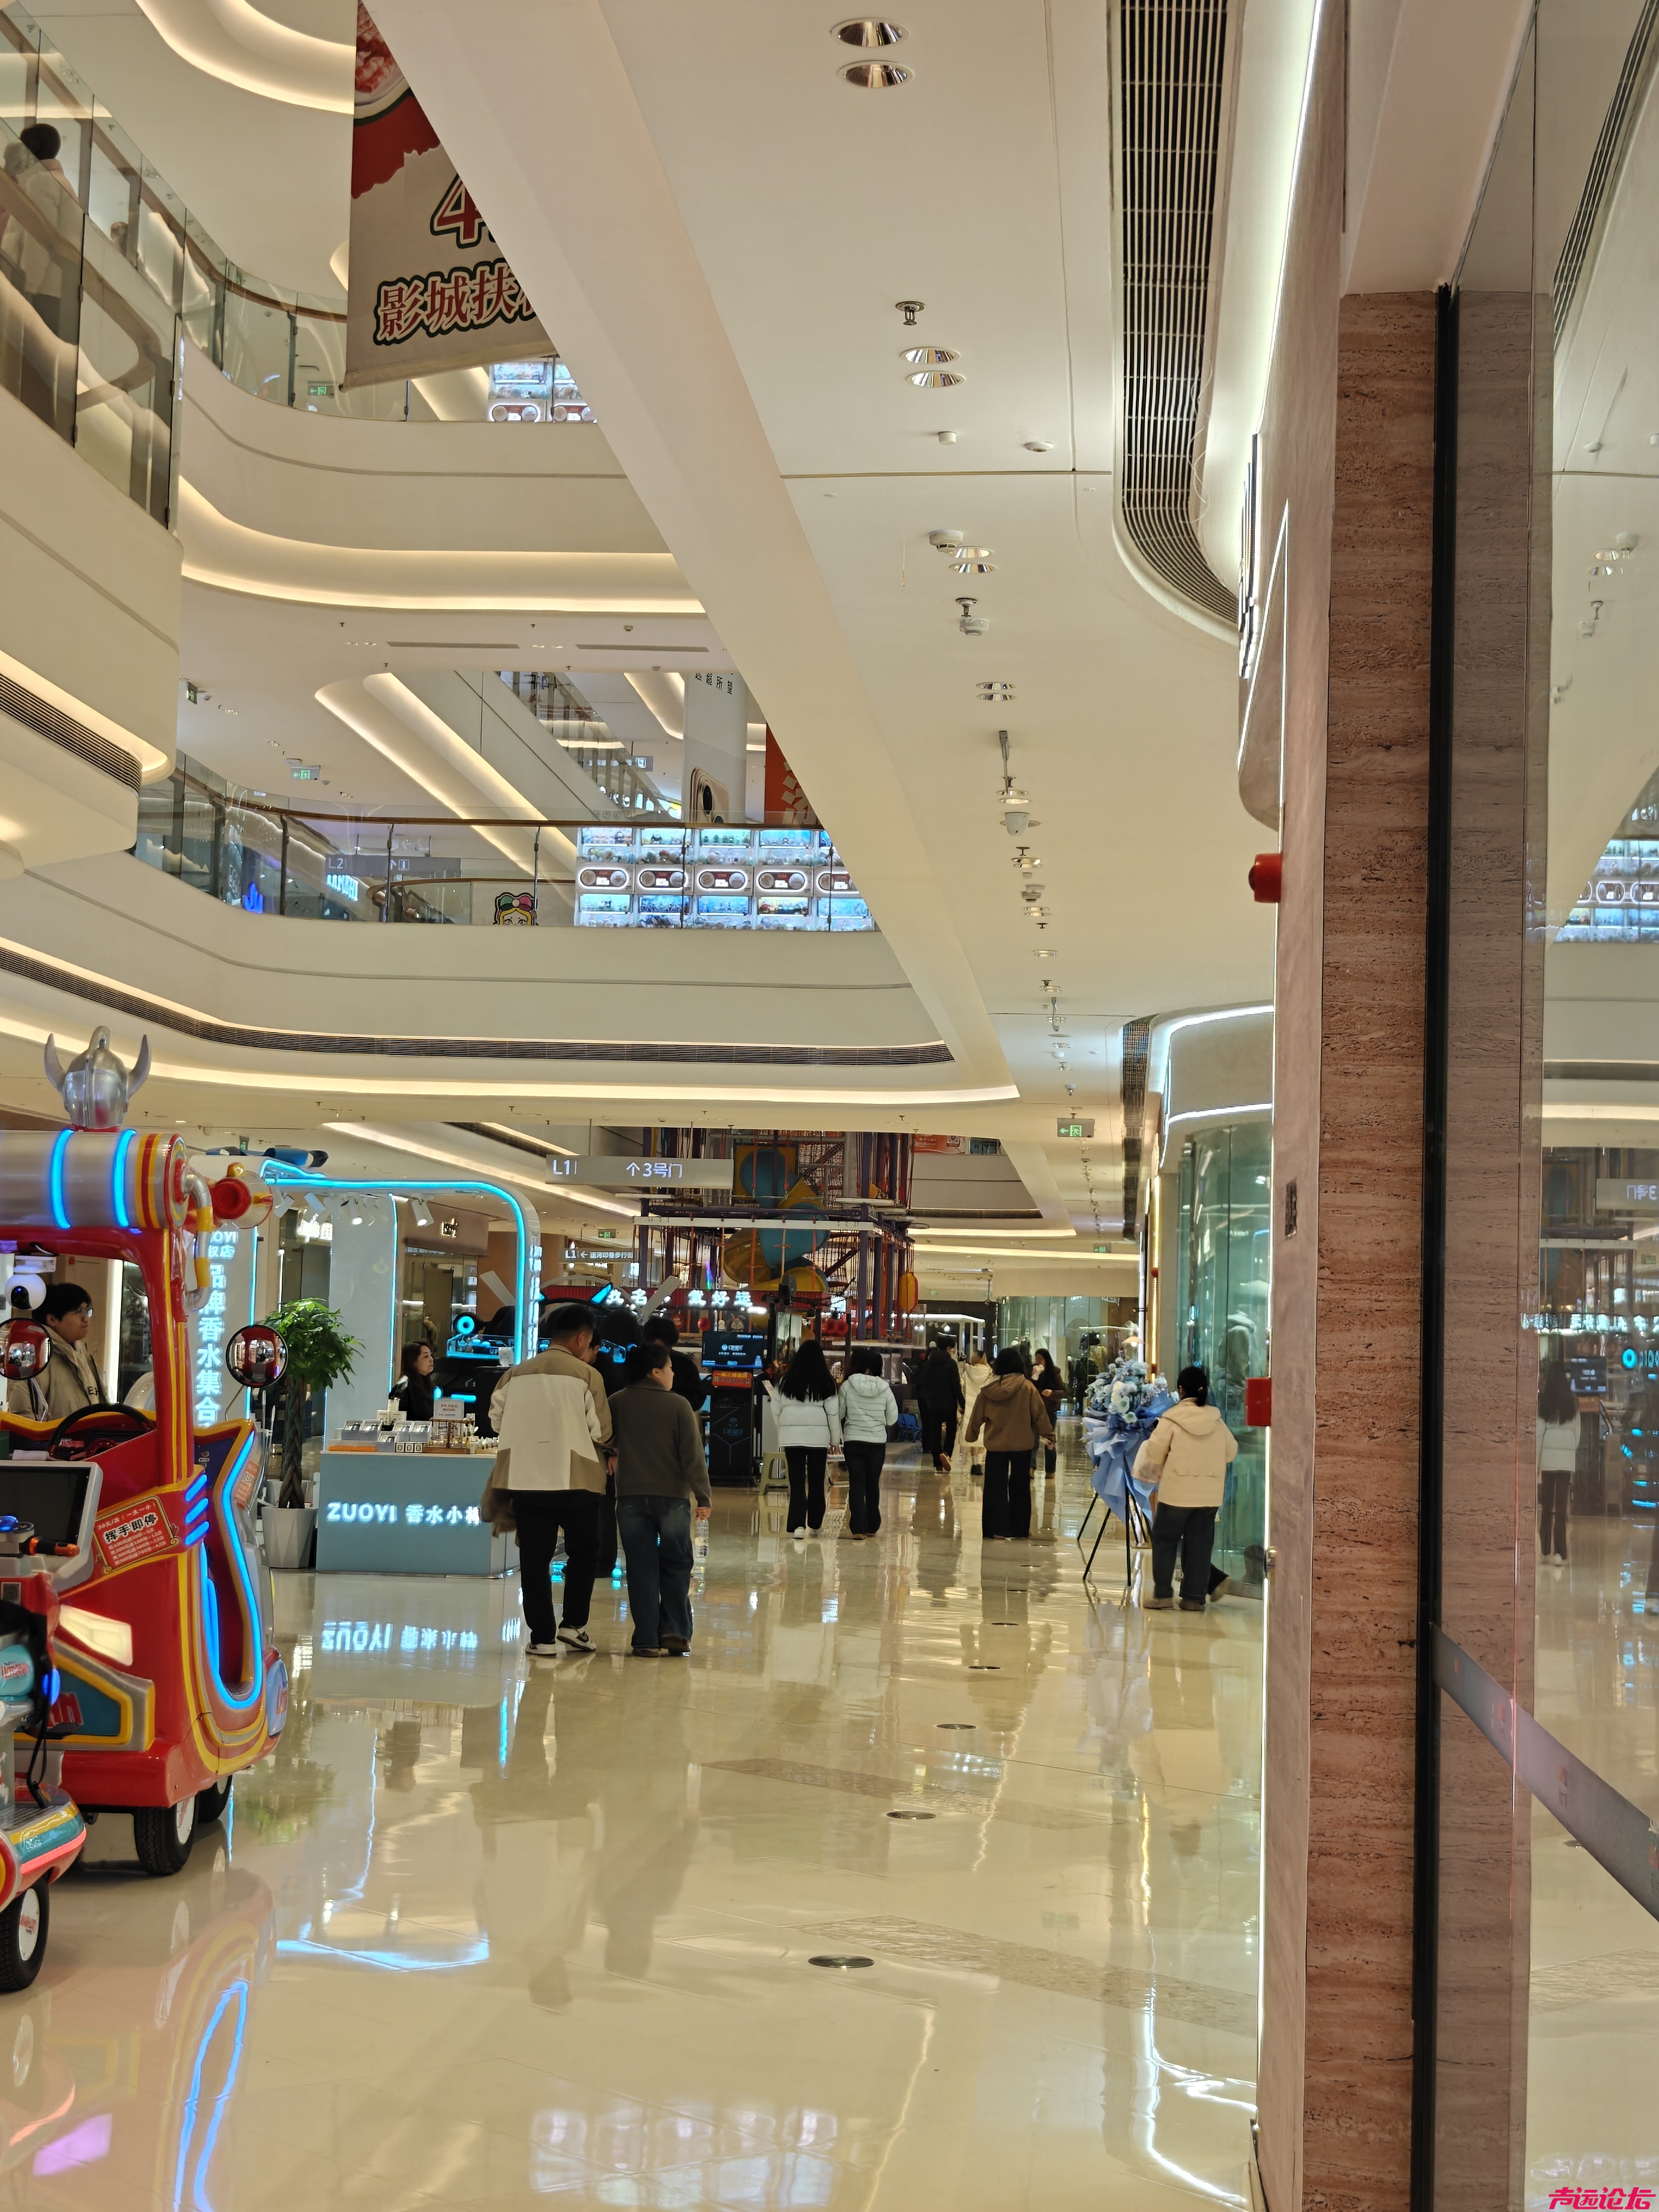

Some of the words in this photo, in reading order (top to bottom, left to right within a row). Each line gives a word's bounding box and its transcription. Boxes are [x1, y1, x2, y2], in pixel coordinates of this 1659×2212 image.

[377, 260, 538, 342] 影城扶
[552, 1159, 570, 1175] L1
[643, 1162, 683, 1178] 3号门
[565, 1250, 576, 1258] L1
[327, 1500, 397, 1522] ZUOYI
[103, 1513, 157, 1543] 挥手即停
